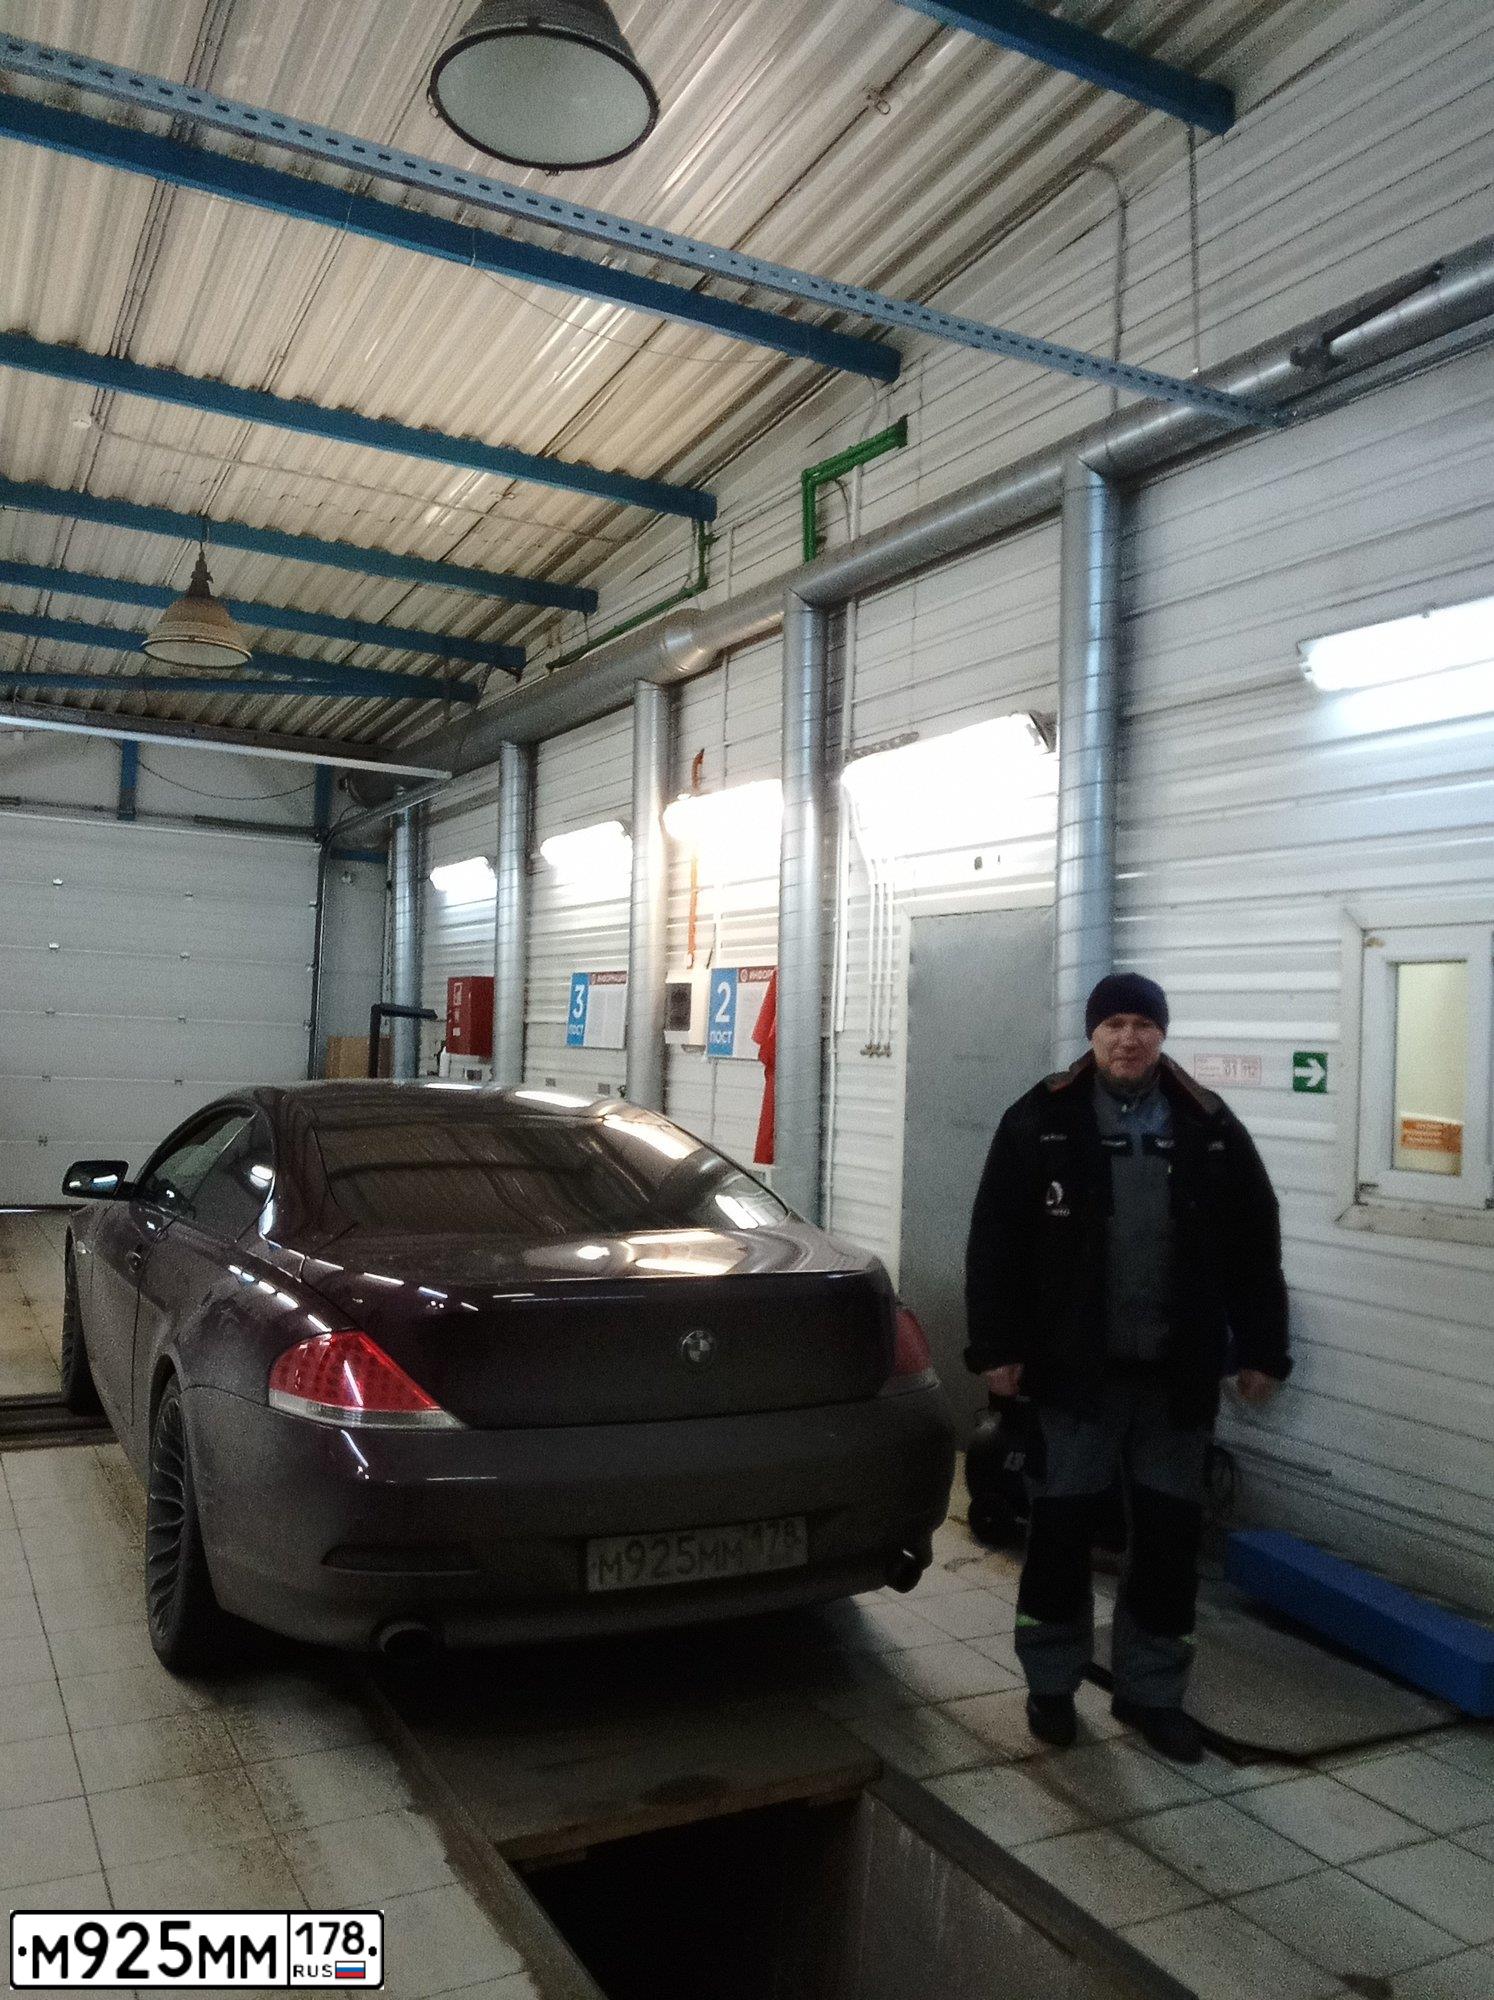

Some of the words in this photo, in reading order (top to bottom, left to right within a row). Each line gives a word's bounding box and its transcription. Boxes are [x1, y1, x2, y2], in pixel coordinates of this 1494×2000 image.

[572, 984, 585, 1019] 3
[715, 981, 731, 1023] 2
[709, 1030, 733, 1044] ПОСТ
[597, 1533, 744, 1584] М925ММ
